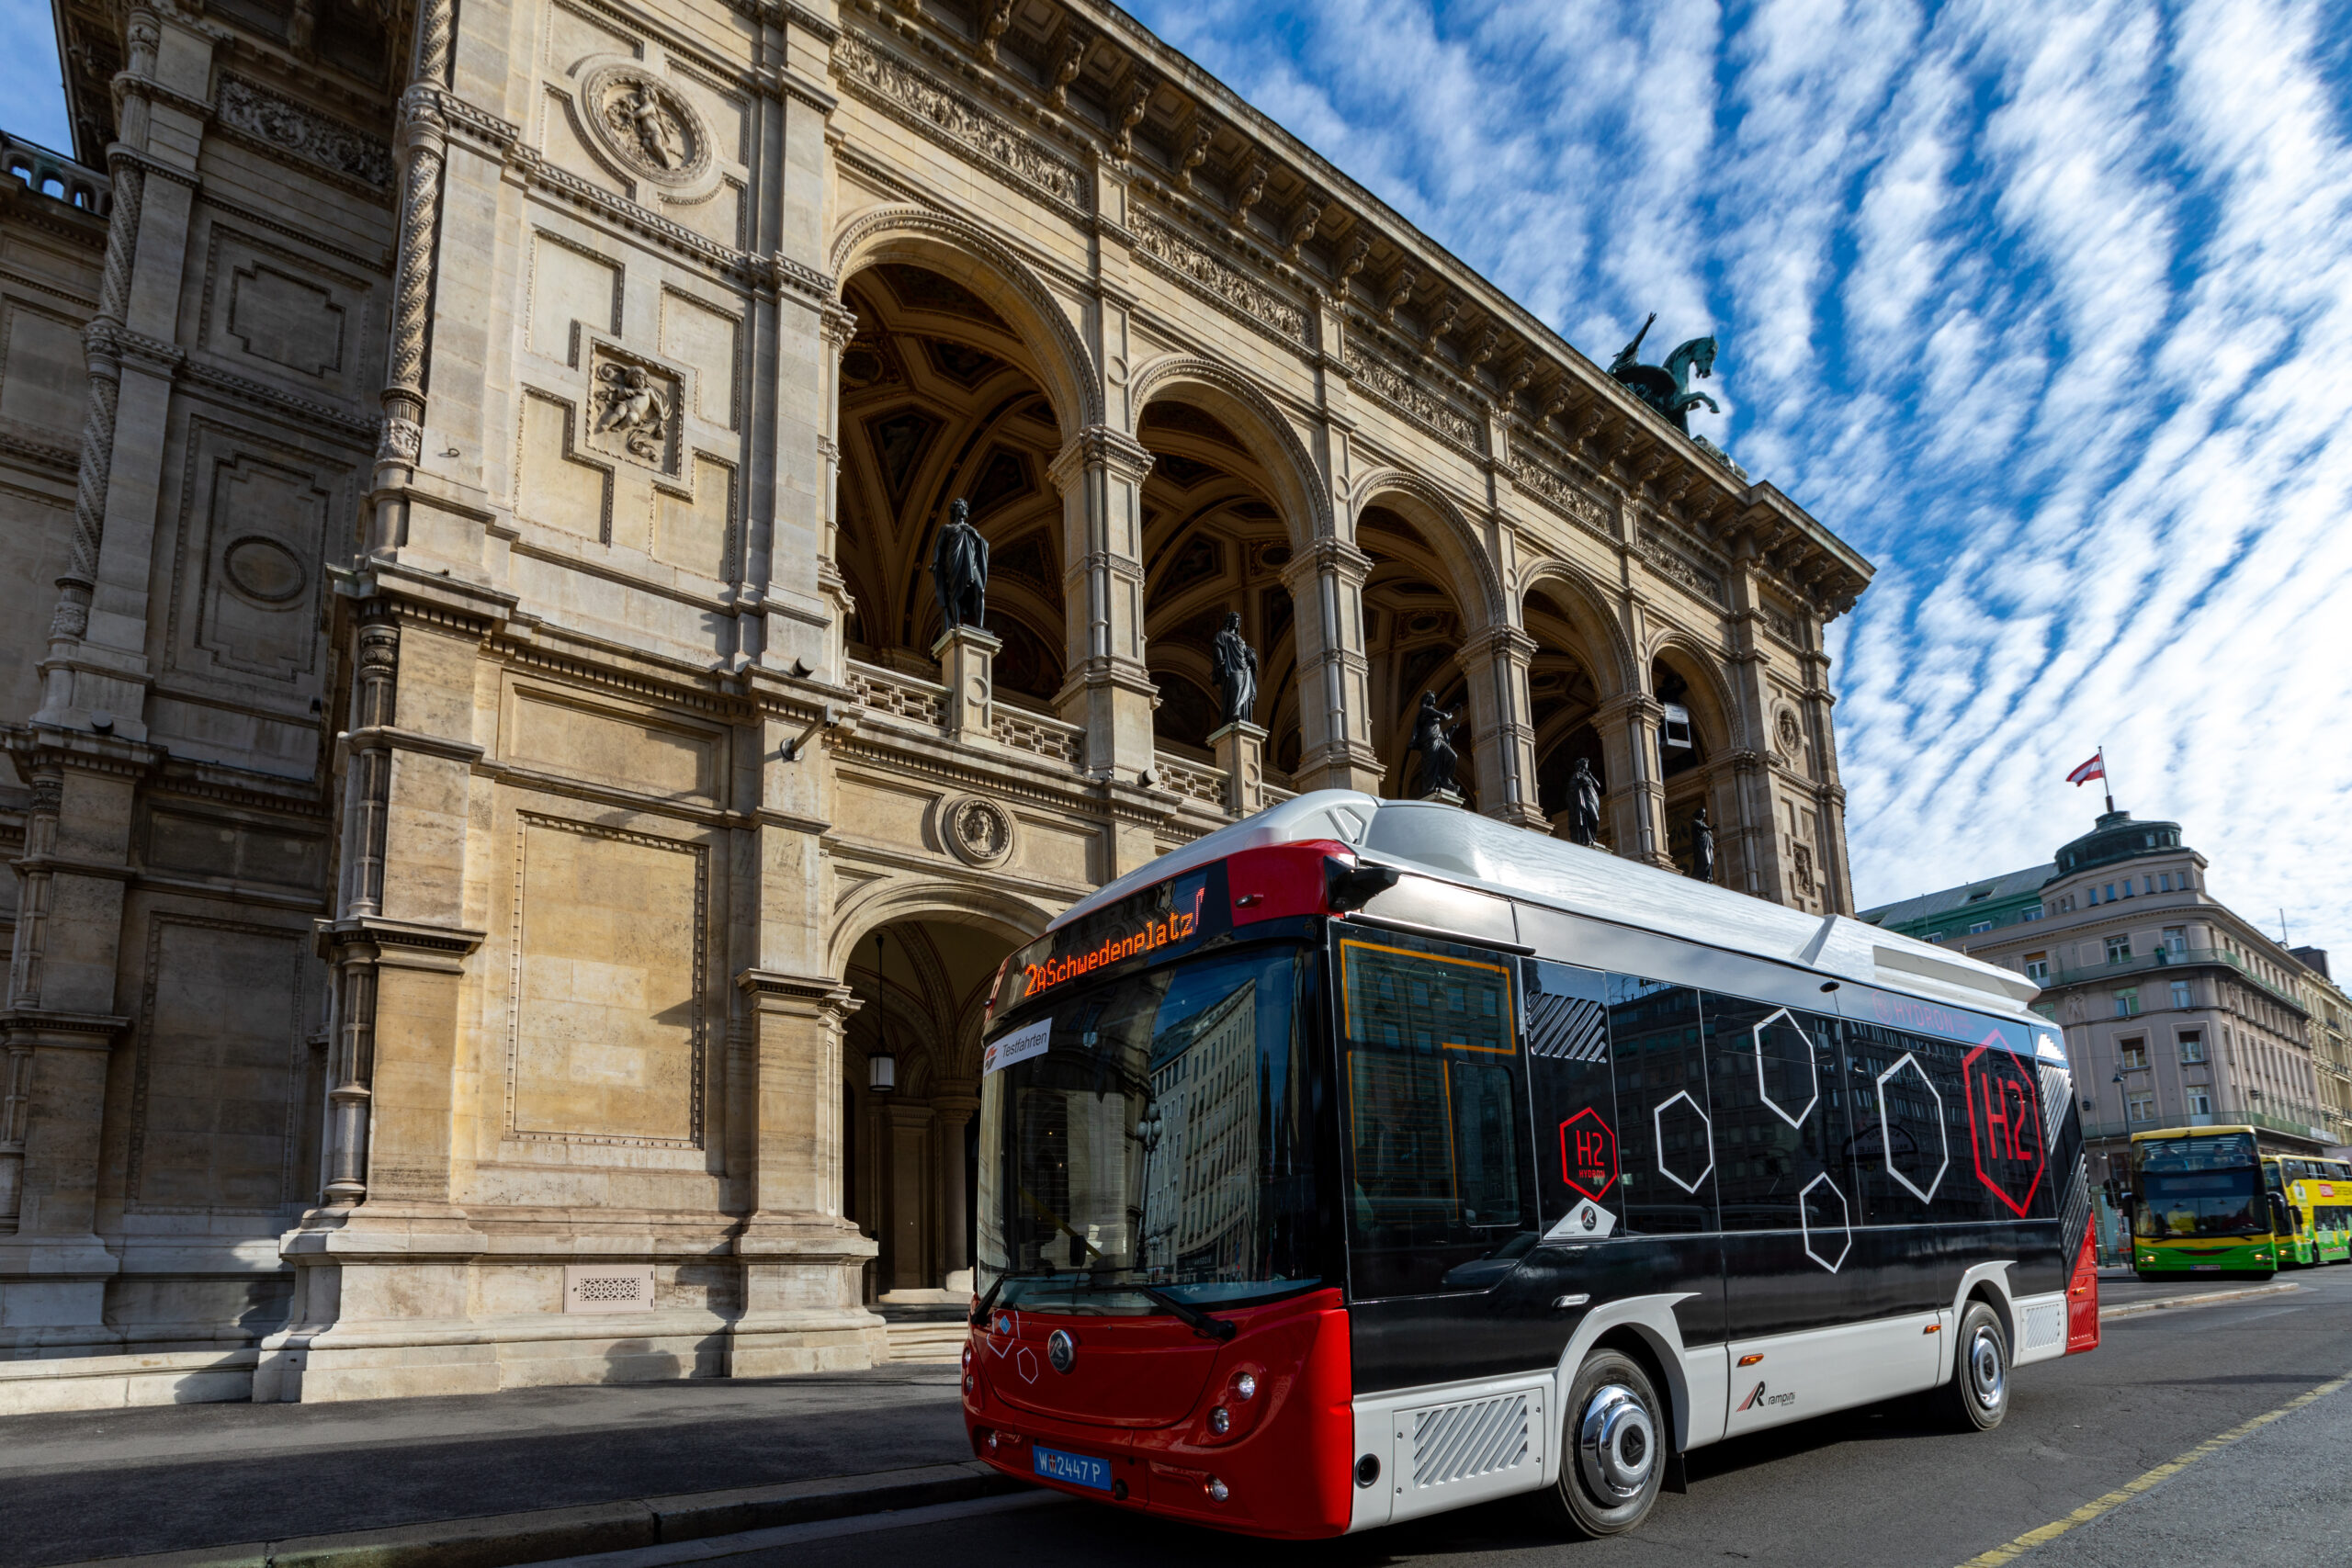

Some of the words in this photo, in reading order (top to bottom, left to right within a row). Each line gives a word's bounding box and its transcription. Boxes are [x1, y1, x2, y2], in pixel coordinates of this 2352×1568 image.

[1046, 912, 1193, 987] Schwedenplatz
[1893, 998, 1954, 1033] HYDRON
[1002, 1032, 1047, 1058] Testfahrten
[1981, 1072, 2032, 1161] H2
[1576, 1130, 1605, 1167] H2
[1768, 1391, 1797, 1406] rampini
[1038, 1450, 1047, 1472] W
[1057, 1456, 1088, 1481] 2447
[1091, 1462, 1101, 1483] P
